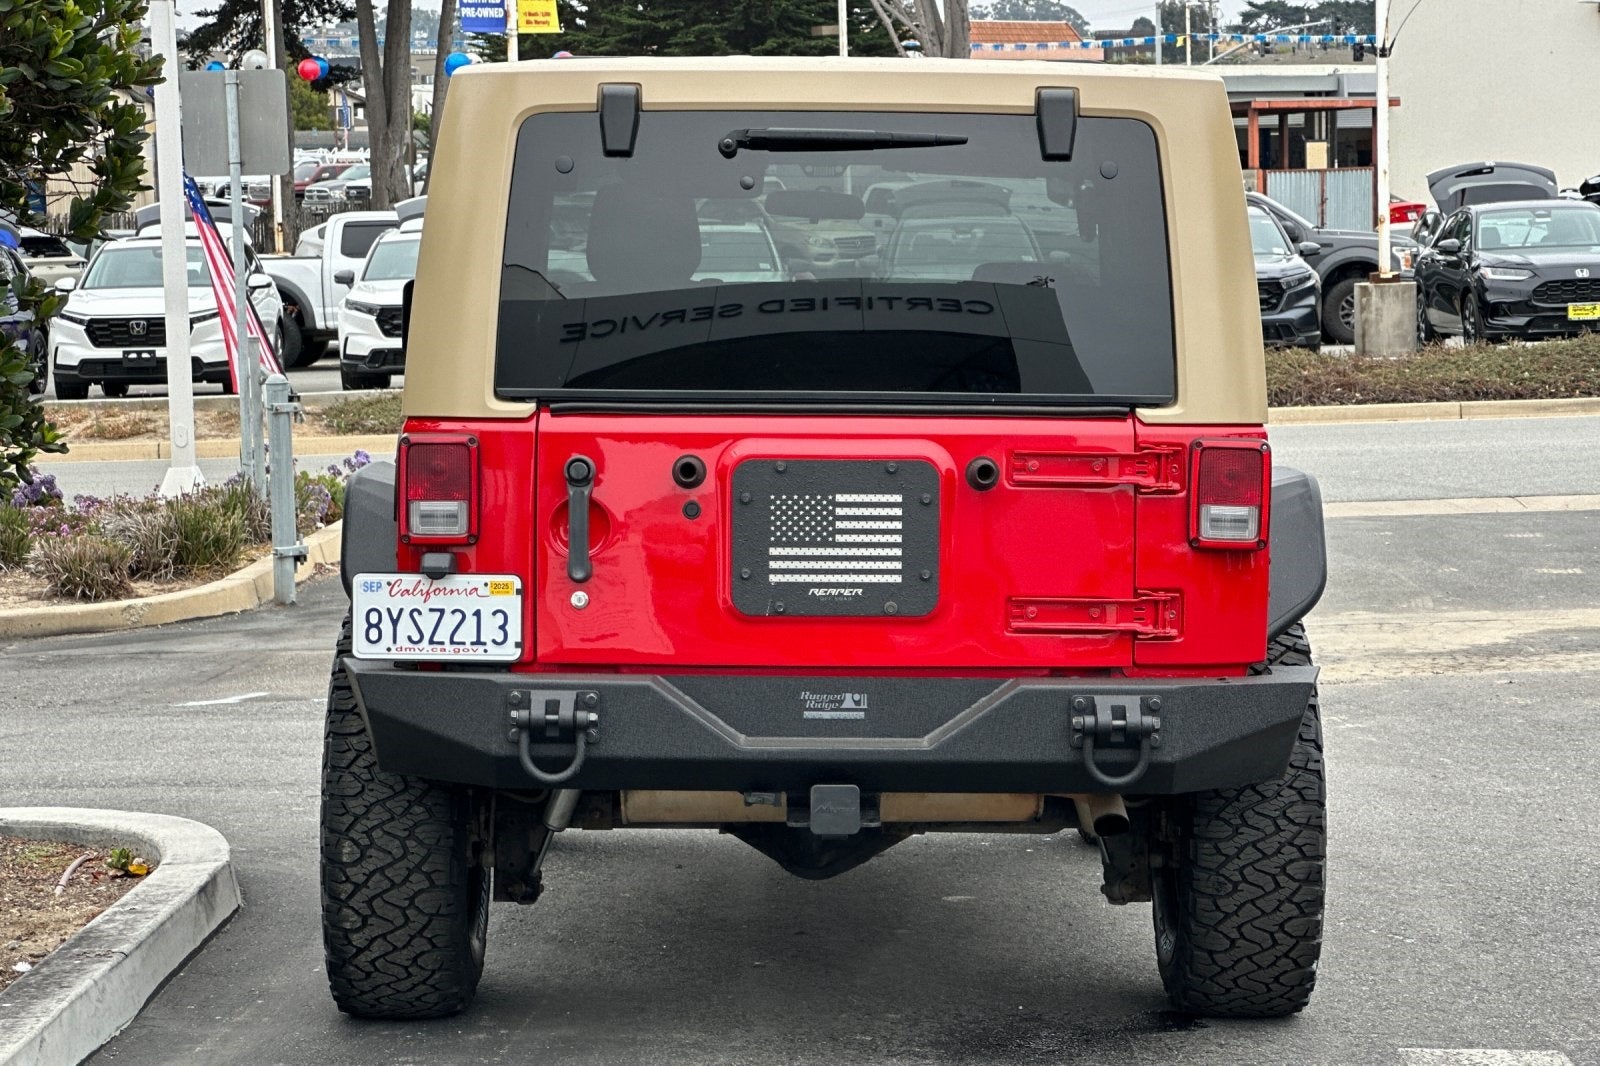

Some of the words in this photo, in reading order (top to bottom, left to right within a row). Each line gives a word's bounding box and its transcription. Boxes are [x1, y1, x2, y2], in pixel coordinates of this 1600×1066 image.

[461, 7, 504, 18] PRE-OWNED
[362, 581, 383, 593] SEP
[388, 578, 490, 604] California
[493, 582, 510, 590] 2025
[808, 588, 864, 597] REAPER
[365, 607, 509, 646] 8YSZ213
[395, 646, 479, 654] dmv.ca.gov
[800, 691, 845, 702] Rugged
[806, 700, 839, 711] Ridge
